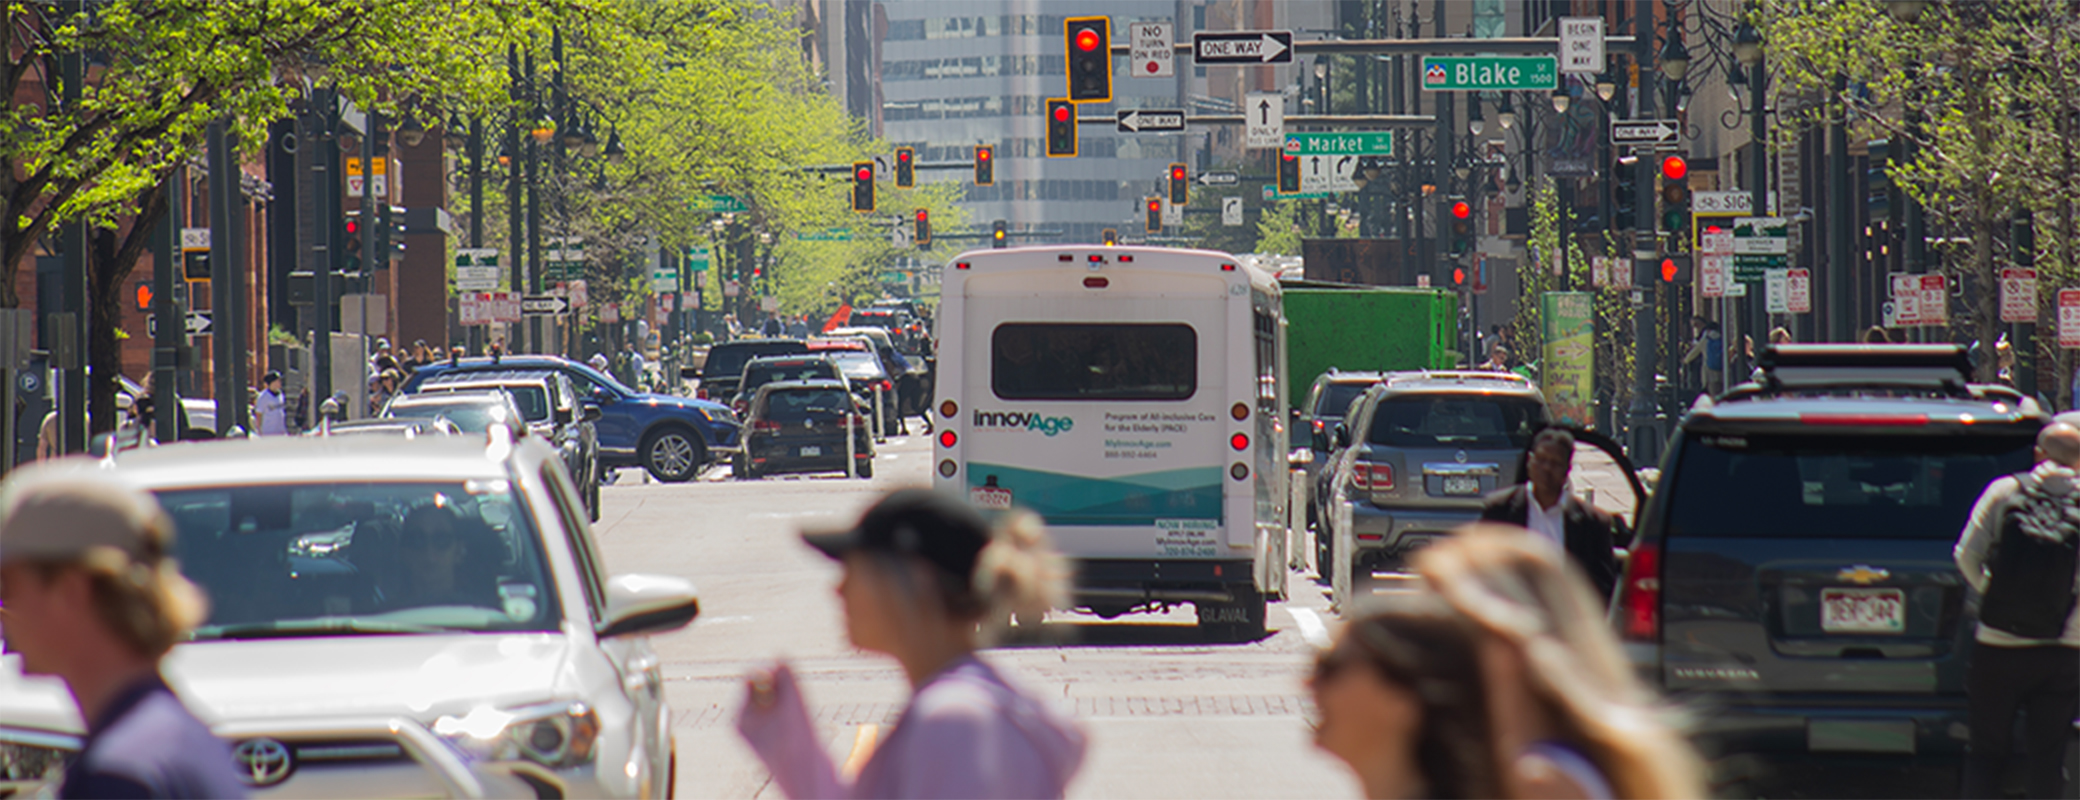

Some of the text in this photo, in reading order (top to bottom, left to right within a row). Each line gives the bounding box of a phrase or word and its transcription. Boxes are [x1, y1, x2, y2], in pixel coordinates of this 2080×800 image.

[1142, 26, 1162, 37] NO
[1568, 24, 1597, 35] BEGIN
[1140, 40, 1165, 48] TURN
[1203, 42, 1263, 55] ONE WAY
[1571, 40, 1592, 51] ONE
[1134, 50, 1171, 60] ON RED
[1571, 57, 1592, 66] WAY
[1455, 62, 1521, 85] Blake
[1530, 74, 1553, 84] 1500
[1136, 116, 1178, 126] ONE WAY
[1251, 127, 1278, 136] ONLY
[1618, 127, 1657, 137] ONE WAY
[1308, 136, 1364, 151] Market
[1105, 412, 1138, 422] Program
[1140, 412, 1149, 420] of
[1198, 412, 1216, 421] Care
[973, 409, 1074, 437] innovAge
[1105, 423, 1116, 431] for
[1118, 423, 1131, 431] the
[1133, 423, 1159, 433] Elderly
[1156, 521, 1217, 530] NOW HIRING
[1201, 607, 1250, 623] GLAVAL
